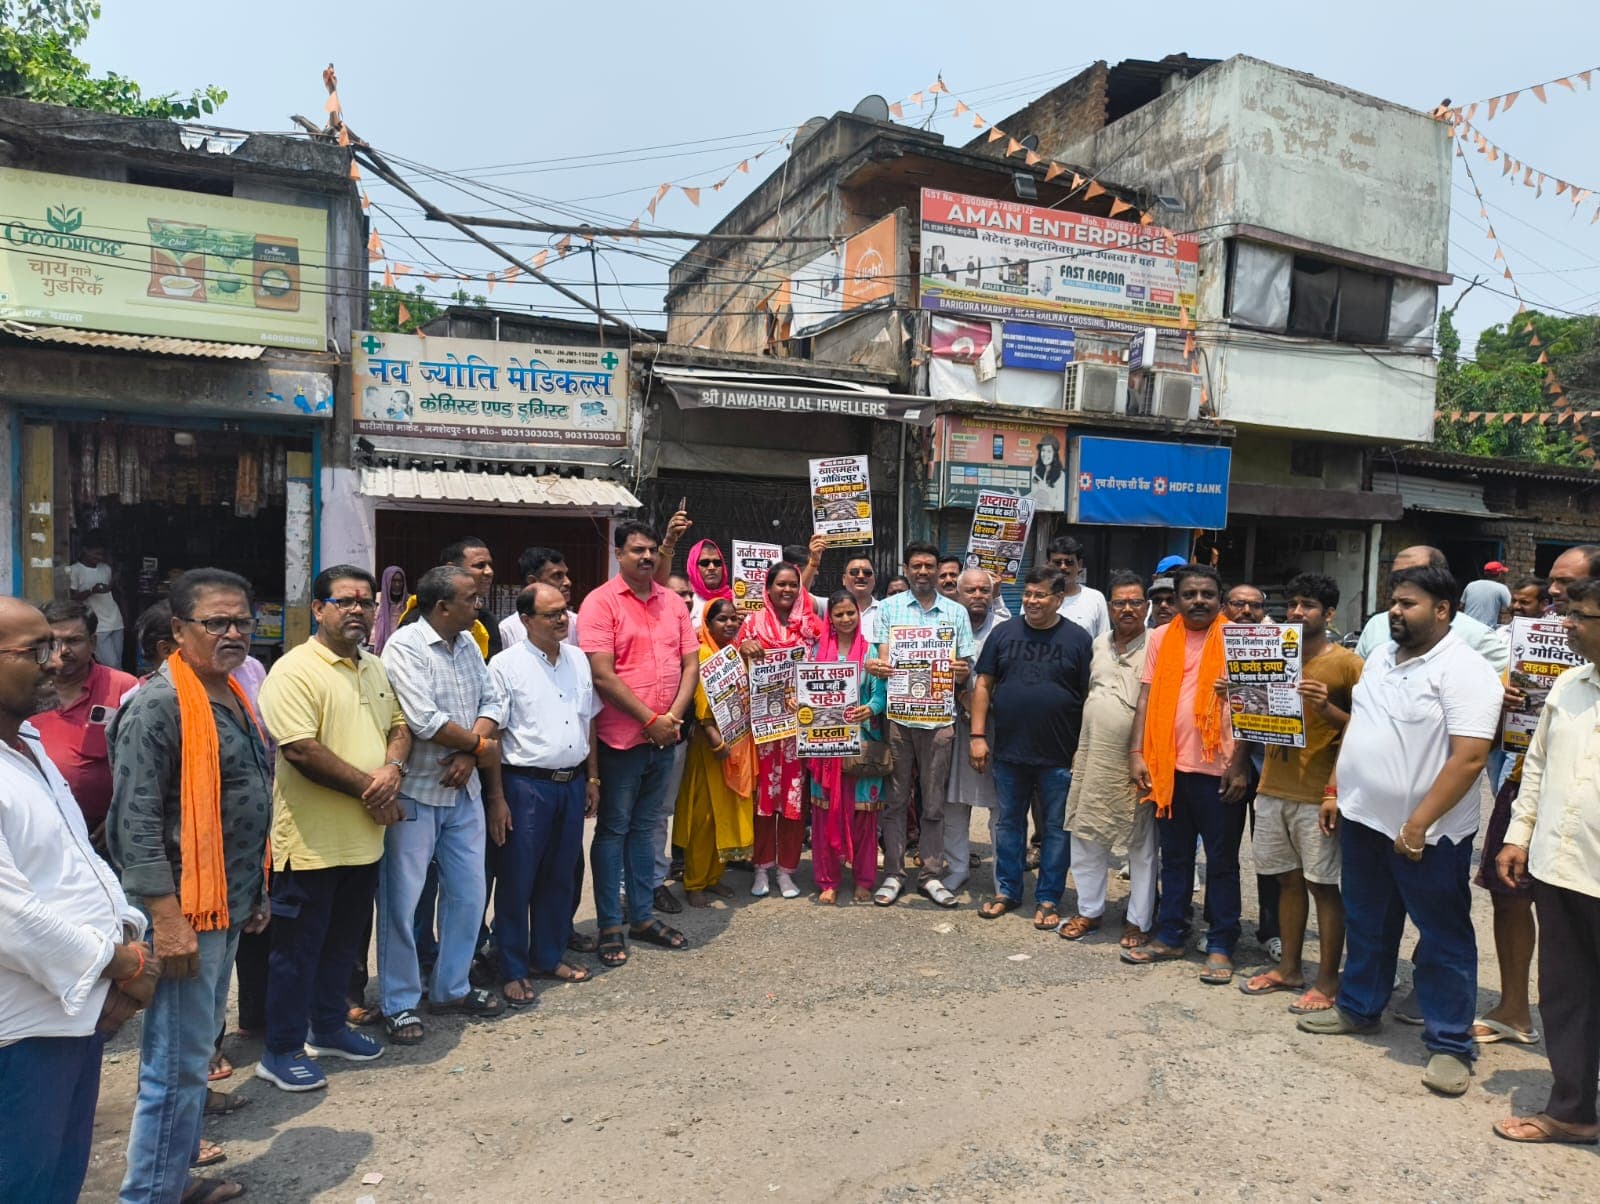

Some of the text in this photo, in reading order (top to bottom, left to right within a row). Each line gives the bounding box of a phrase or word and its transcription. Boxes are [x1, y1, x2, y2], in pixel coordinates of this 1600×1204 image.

[947, 204, 1023, 232] AMAN
[1029, 217, 1178, 256] ENTERPRISES
[27, 257, 92, 278] चाय माने
[1060, 264, 1085, 279] FAST
[1088, 268, 1125, 286] REPAIR
[41, 277, 104, 297] गुडरिक
[940, 298, 979, 312] BARIGORA
[980, 303, 1012, 317] MARKET,
[1014, 308, 1035, 318] NEAR
[1036, 311, 1068, 325] RAILWAY
[1069, 315, 1107, 329] CROSSING,
[368, 352, 613, 397] नव ज्योति मेडिकल्स
[419, 393, 570, 424] केमिस्ट एण्ड ड्रगिस्ट
[701, 388, 886, 416] श्री JAWAHAR LAL JEWELLERS
[961, 418, 988, 429] AMAN
[501, 428, 562, 440] 9031303035,
[565, 431, 621, 441] 9031303036
[818, 464, 860, 475] खासमहल
[821, 473, 858, 484] गोविंदपुर
[1169, 481, 1222, 495] HDFC BANK
[894, 628, 933, 641] सड़क
[921, 638, 953, 649] अधिकार
[907, 650, 937, 660] हमारा
[1227, 647, 1246, 659] शुरू
[701, 655, 725, 678] सड़क
[935, 661, 950, 672] 18
[1228, 661, 1240, 673] 18
[1523, 662, 1548, 674] सड़क
[799, 666, 855, 681] जर्जर सड़क
[736, 676, 748, 687] 18
[809, 691, 846, 706] सहेंगे
[812, 727, 845, 738] धरना
